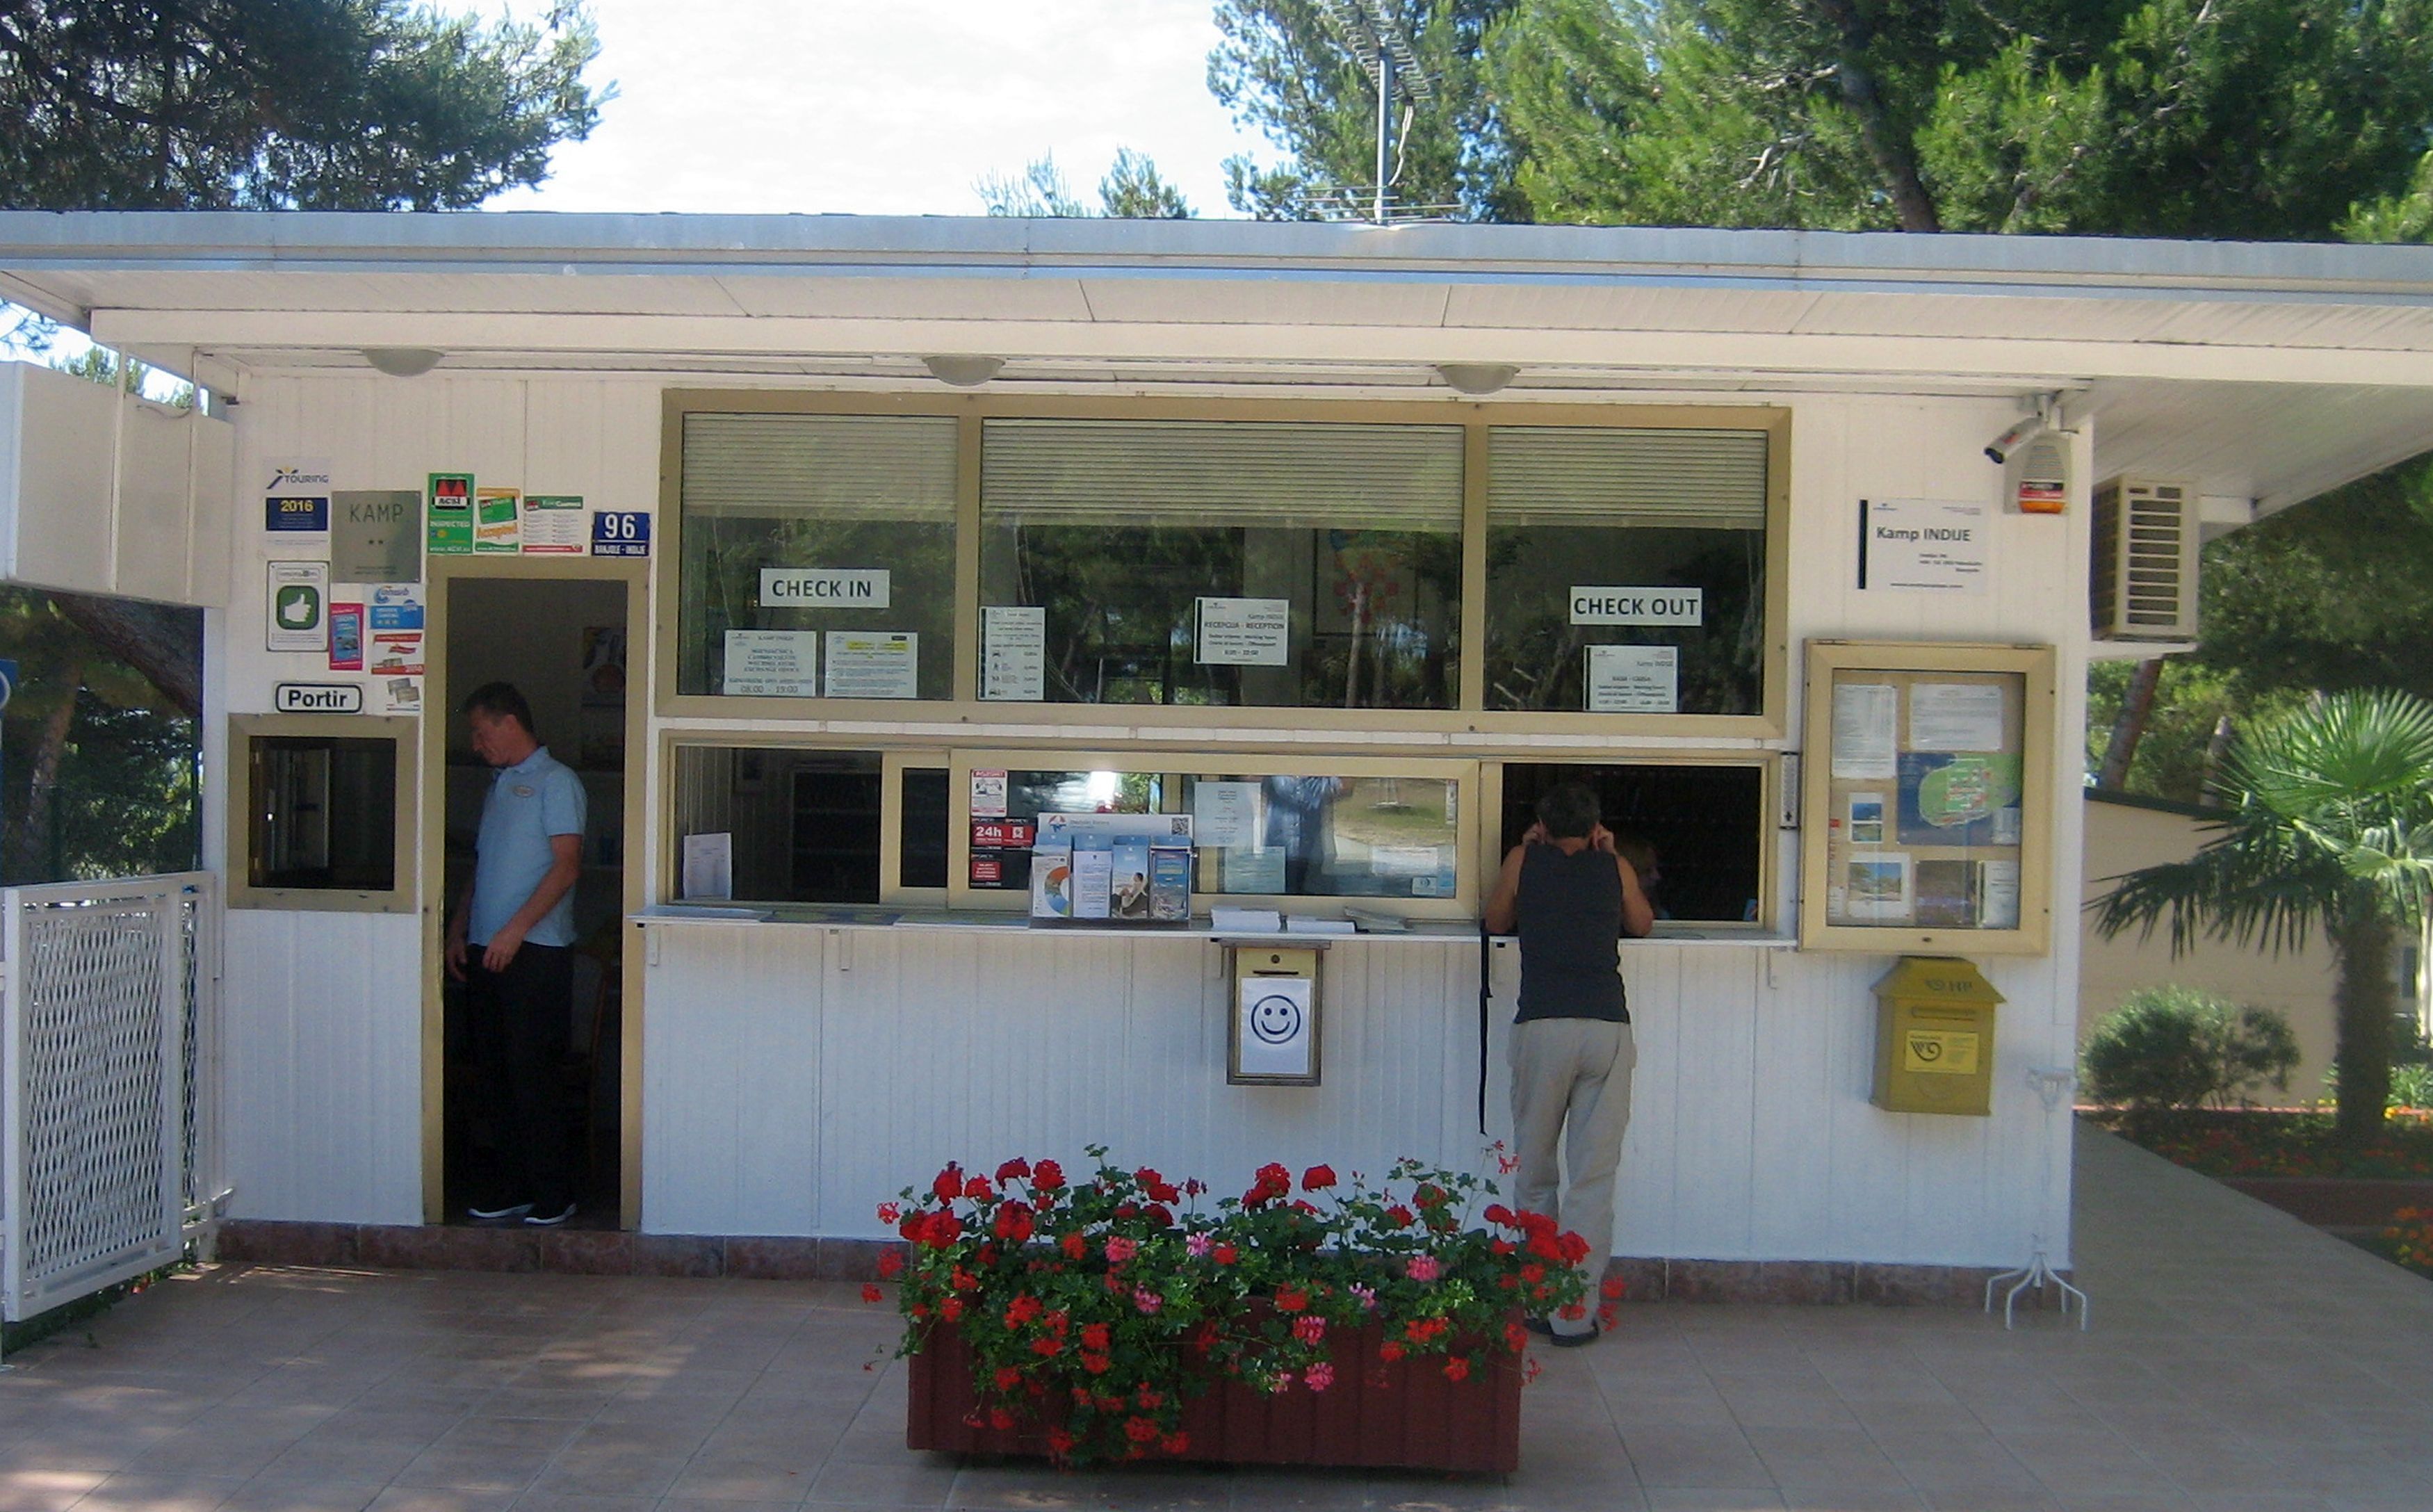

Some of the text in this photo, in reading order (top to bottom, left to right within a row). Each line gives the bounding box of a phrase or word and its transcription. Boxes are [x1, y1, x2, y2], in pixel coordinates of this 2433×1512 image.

[284, 475, 329, 484] TOURING
[350, 503, 404, 523] KAMP
[604, 514, 635, 539] 96
[1876, 526, 1920, 542] Kamp
[772, 580, 872, 598] CHECK IN
[1574, 598, 1698, 616] CHECK OUT
[288, 690, 348, 707] Portir
[975, 826, 1002, 837] 24h
